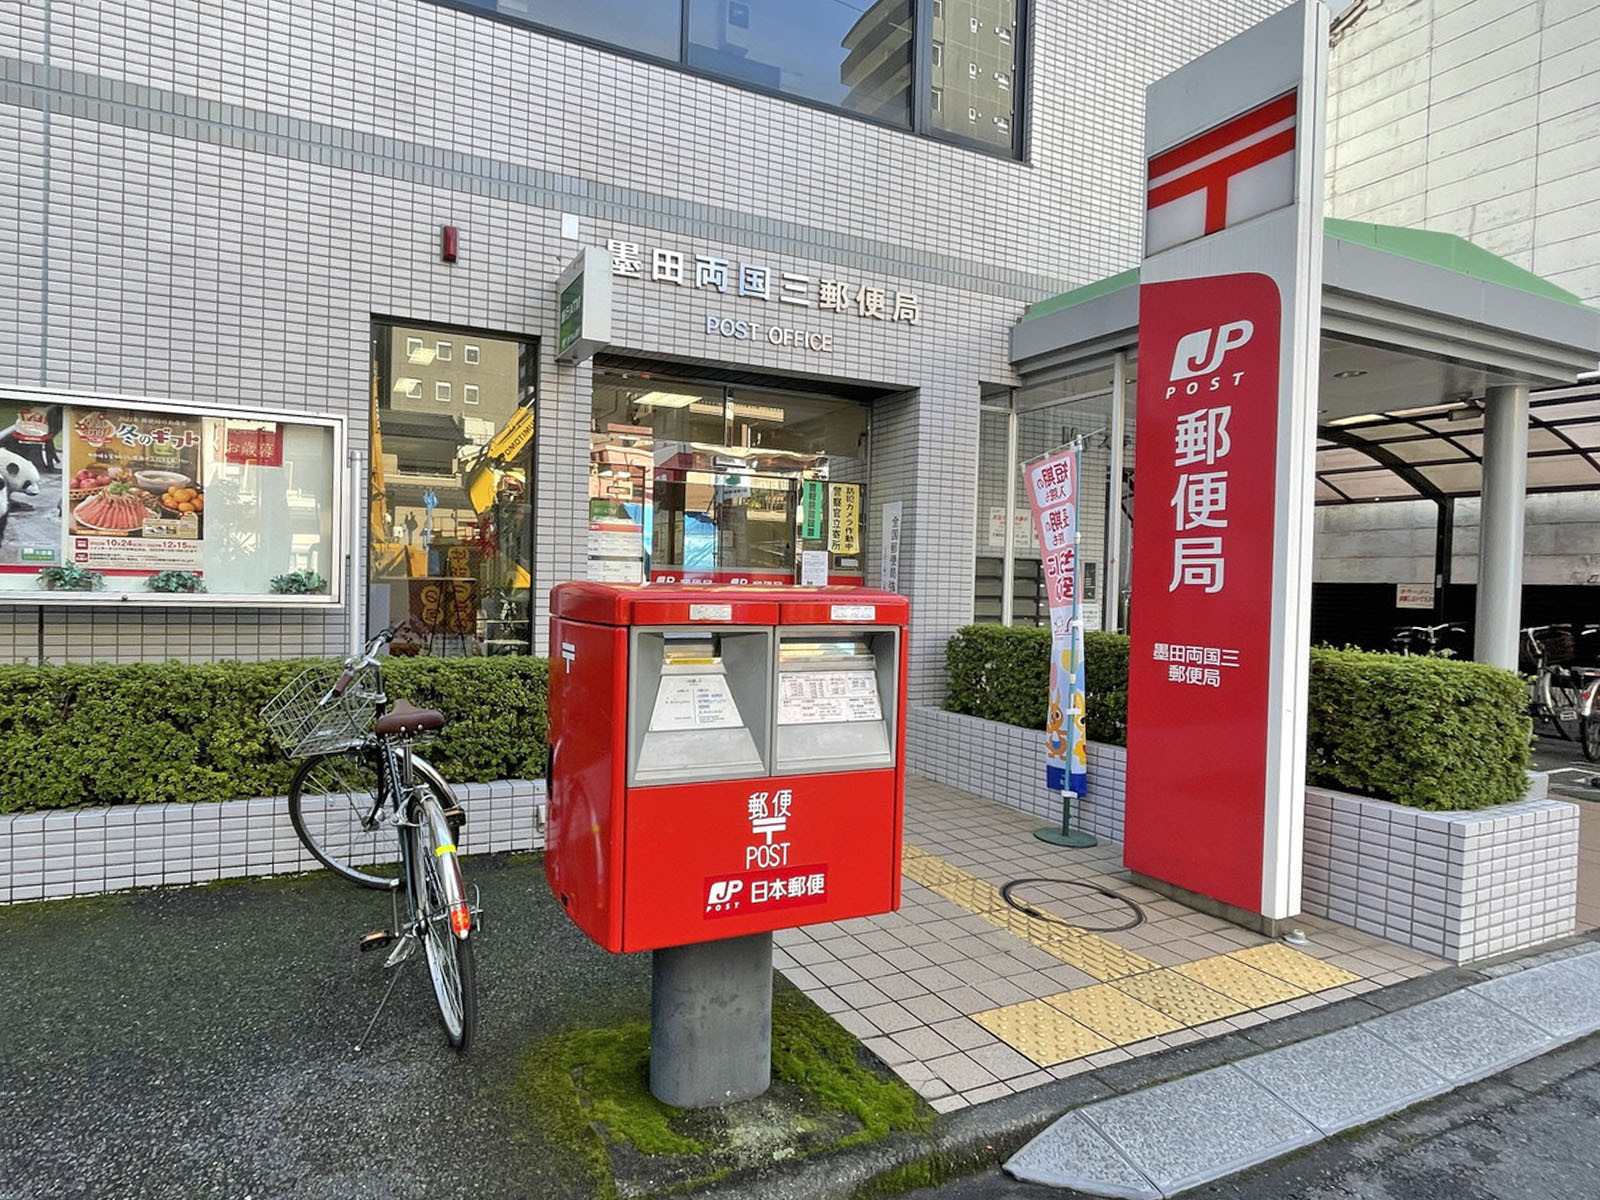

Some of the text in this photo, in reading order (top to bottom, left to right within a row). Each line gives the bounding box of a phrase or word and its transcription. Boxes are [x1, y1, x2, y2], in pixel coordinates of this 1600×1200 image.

[607, 239, 920, 325] 墨田両国三郵便局
[707, 315, 832, 352] POST OFFICE
[1169, 320, 1254, 381] JP
[1166, 372, 1244, 399] POST
[116, 423, 200, 449] 冬のギフト
[1169, 405, 1232, 593] 郵便局
[1152, 643, 1240, 668] 墨田両国三
[1168, 665, 1221, 688] 郵便局
[748, 790, 793, 820] 郵便
[746, 843, 790, 869] POST
[708, 880, 743, 905] JP
[751, 874, 825, 903] 日本郵便
[706, 902, 740, 912] POST
